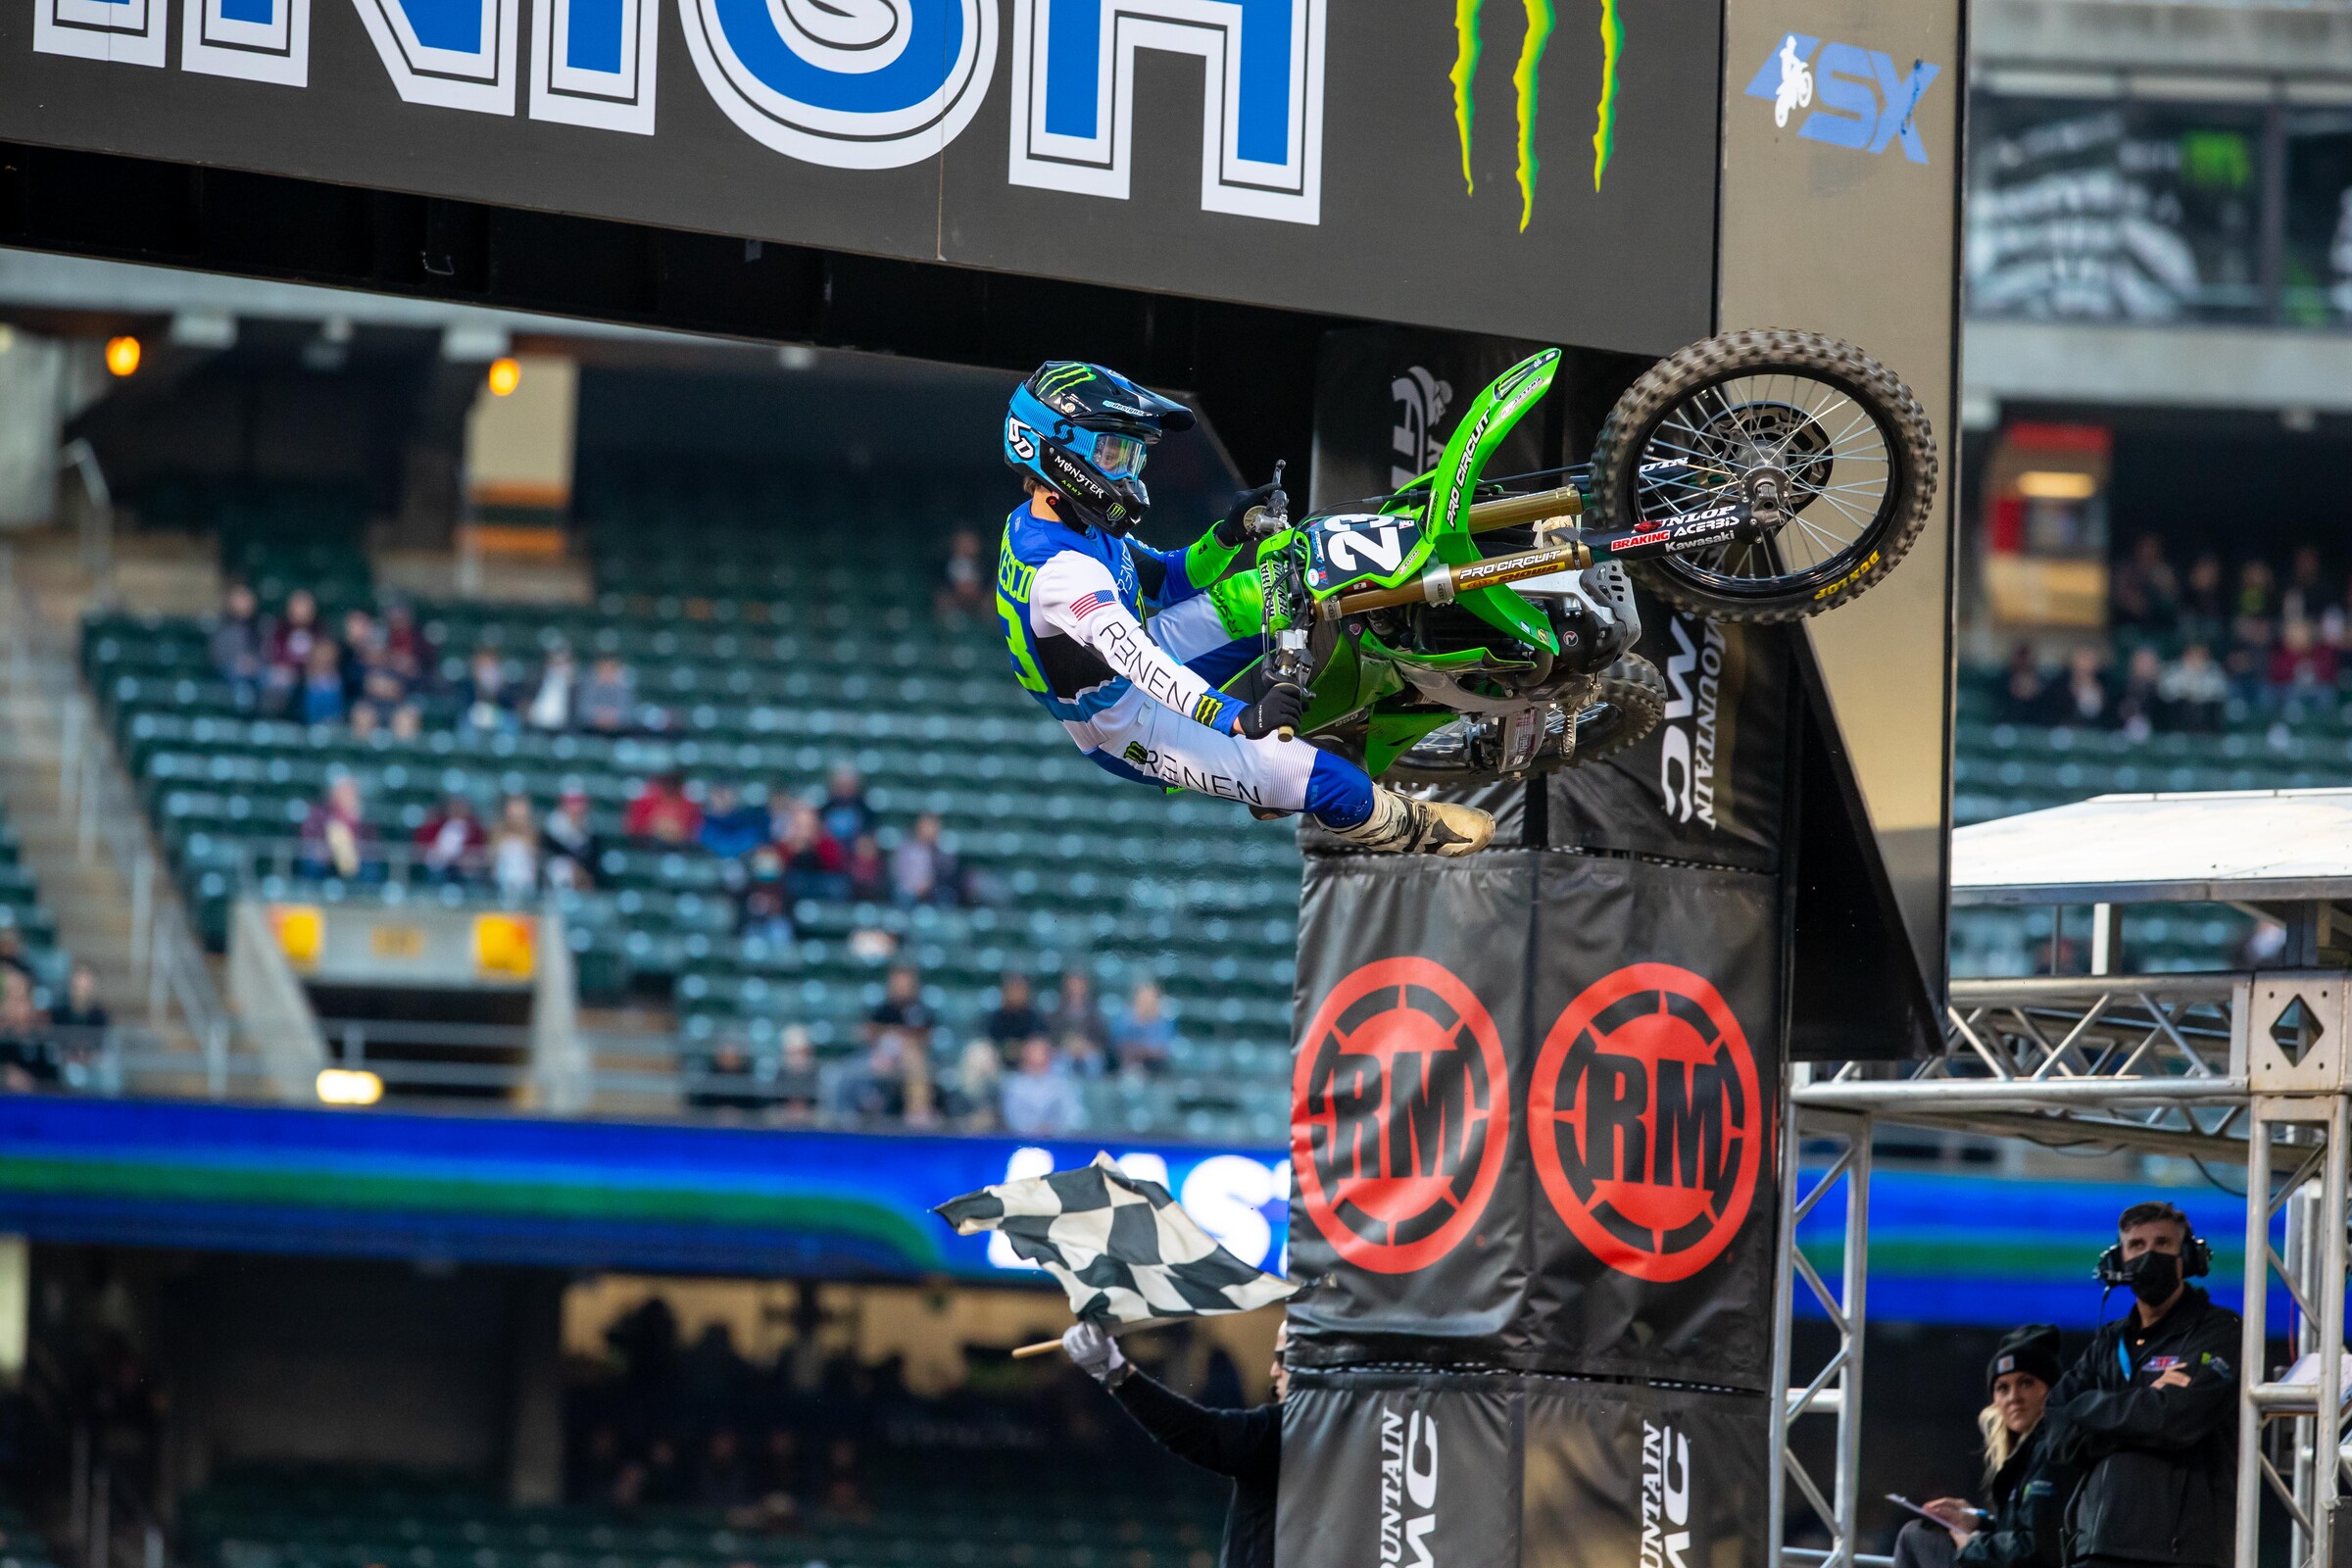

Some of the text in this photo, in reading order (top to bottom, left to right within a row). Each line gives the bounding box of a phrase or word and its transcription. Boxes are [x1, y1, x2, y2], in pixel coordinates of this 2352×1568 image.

[1008, 416, 1035, 460] 6D
[1054, 455, 1105, 499] MONSTER
[1446, 410, 1491, 529] PRO CIRCUIT
[1060, 479, 1083, 497] ARMY
[1631, 505, 1737, 534] UNLOP
[1612, 531, 1670, 551] BRAKING
[1665, 530, 1736, 553] Kawasaki
[1460, 550, 1561, 579] PRO CIRCUIT
[1497, 564, 1558, 583] SHOWA
[1814, 551, 1881, 600] DUNLOP
